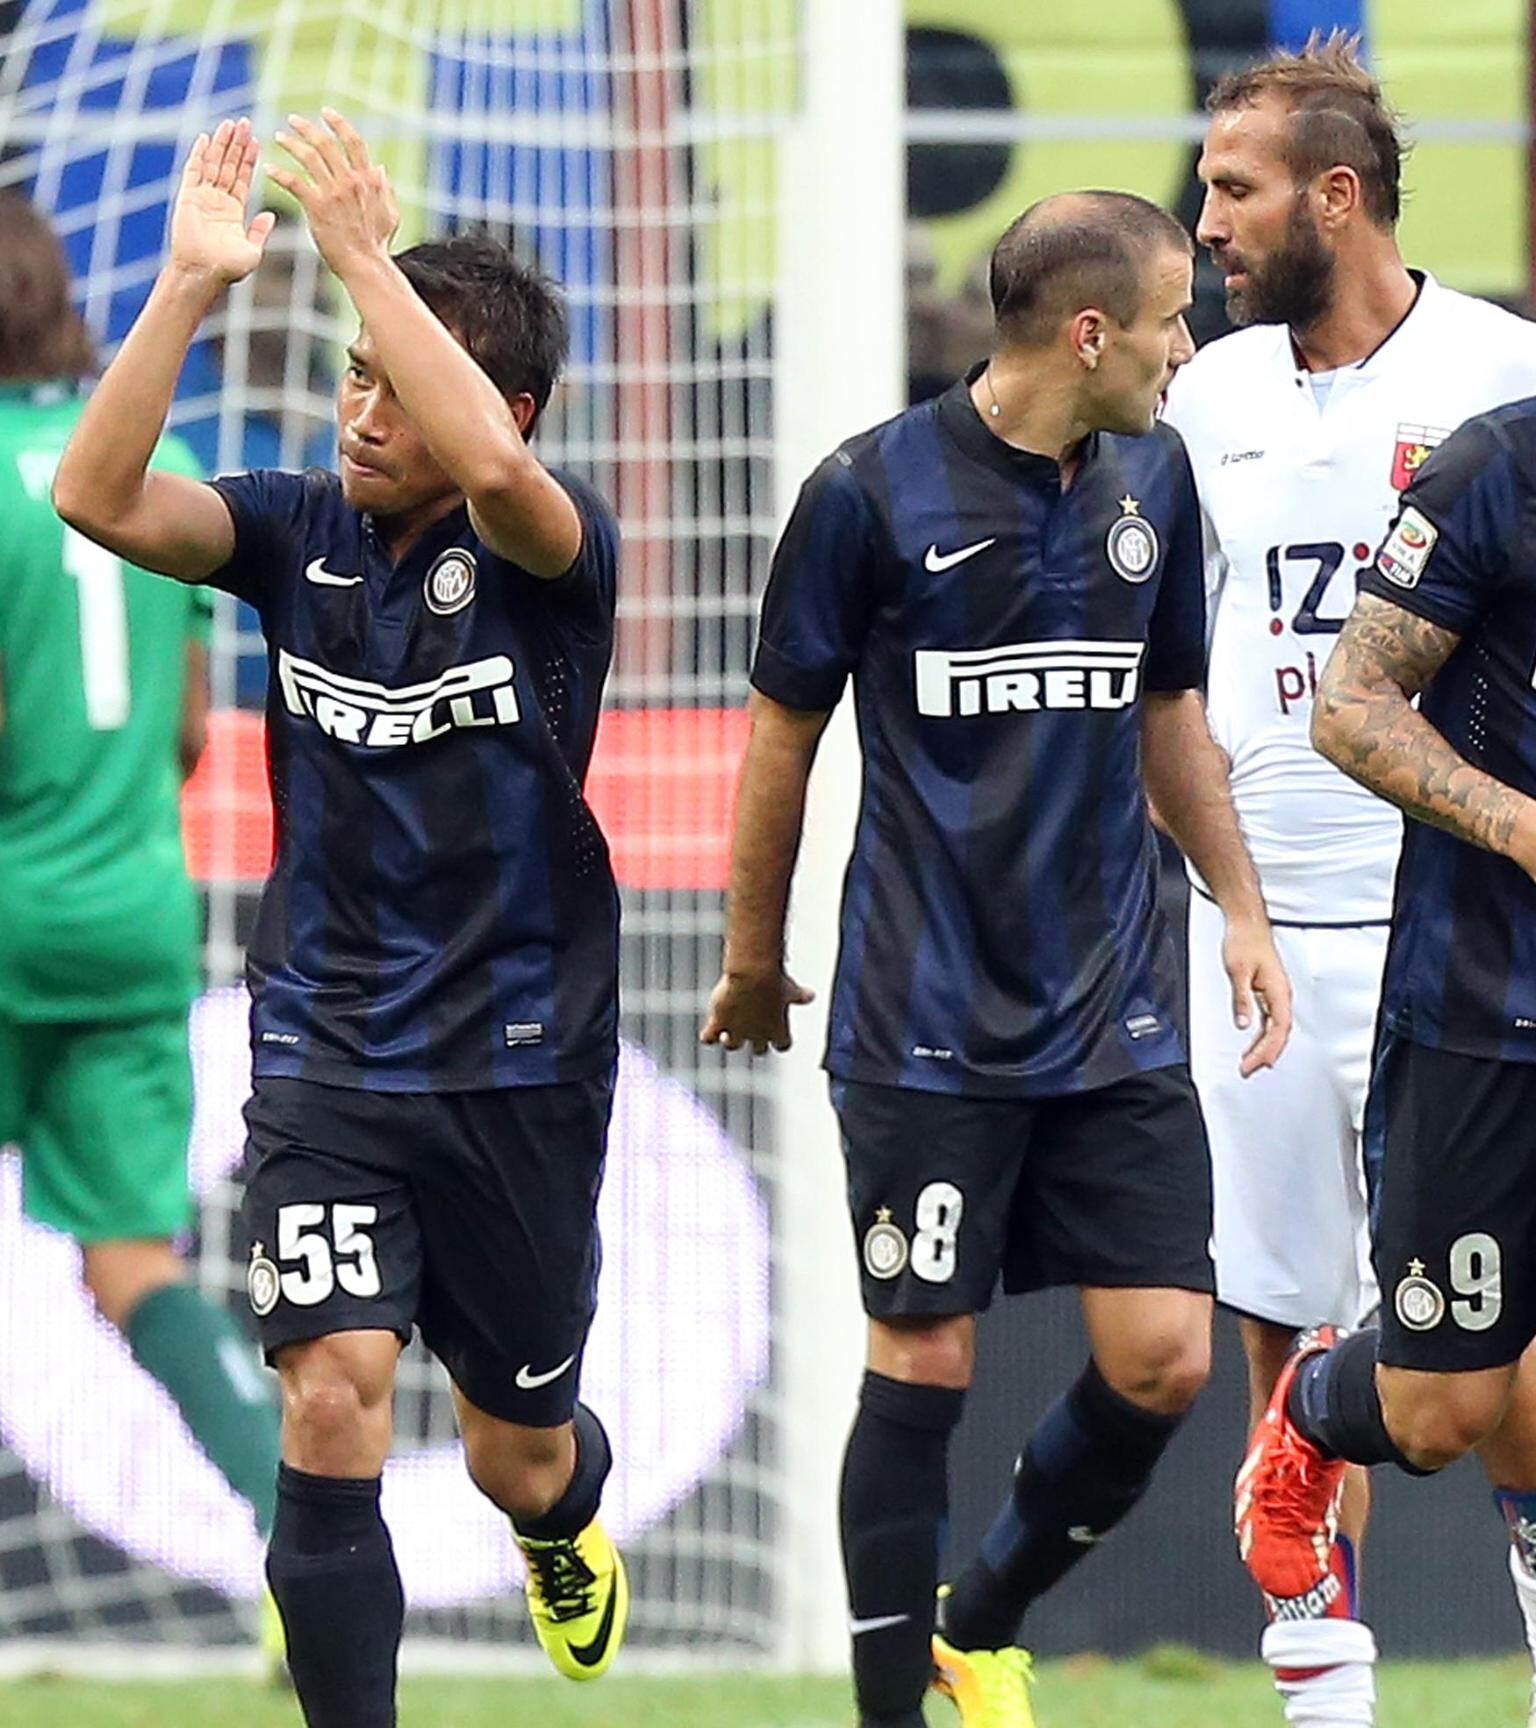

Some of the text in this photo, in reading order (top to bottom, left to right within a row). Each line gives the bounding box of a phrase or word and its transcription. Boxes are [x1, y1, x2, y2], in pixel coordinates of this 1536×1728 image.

[277, 1202, 382, 1306] 55
[910, 1181, 964, 1283] 8
[1449, 1232, 1502, 1331] 9
